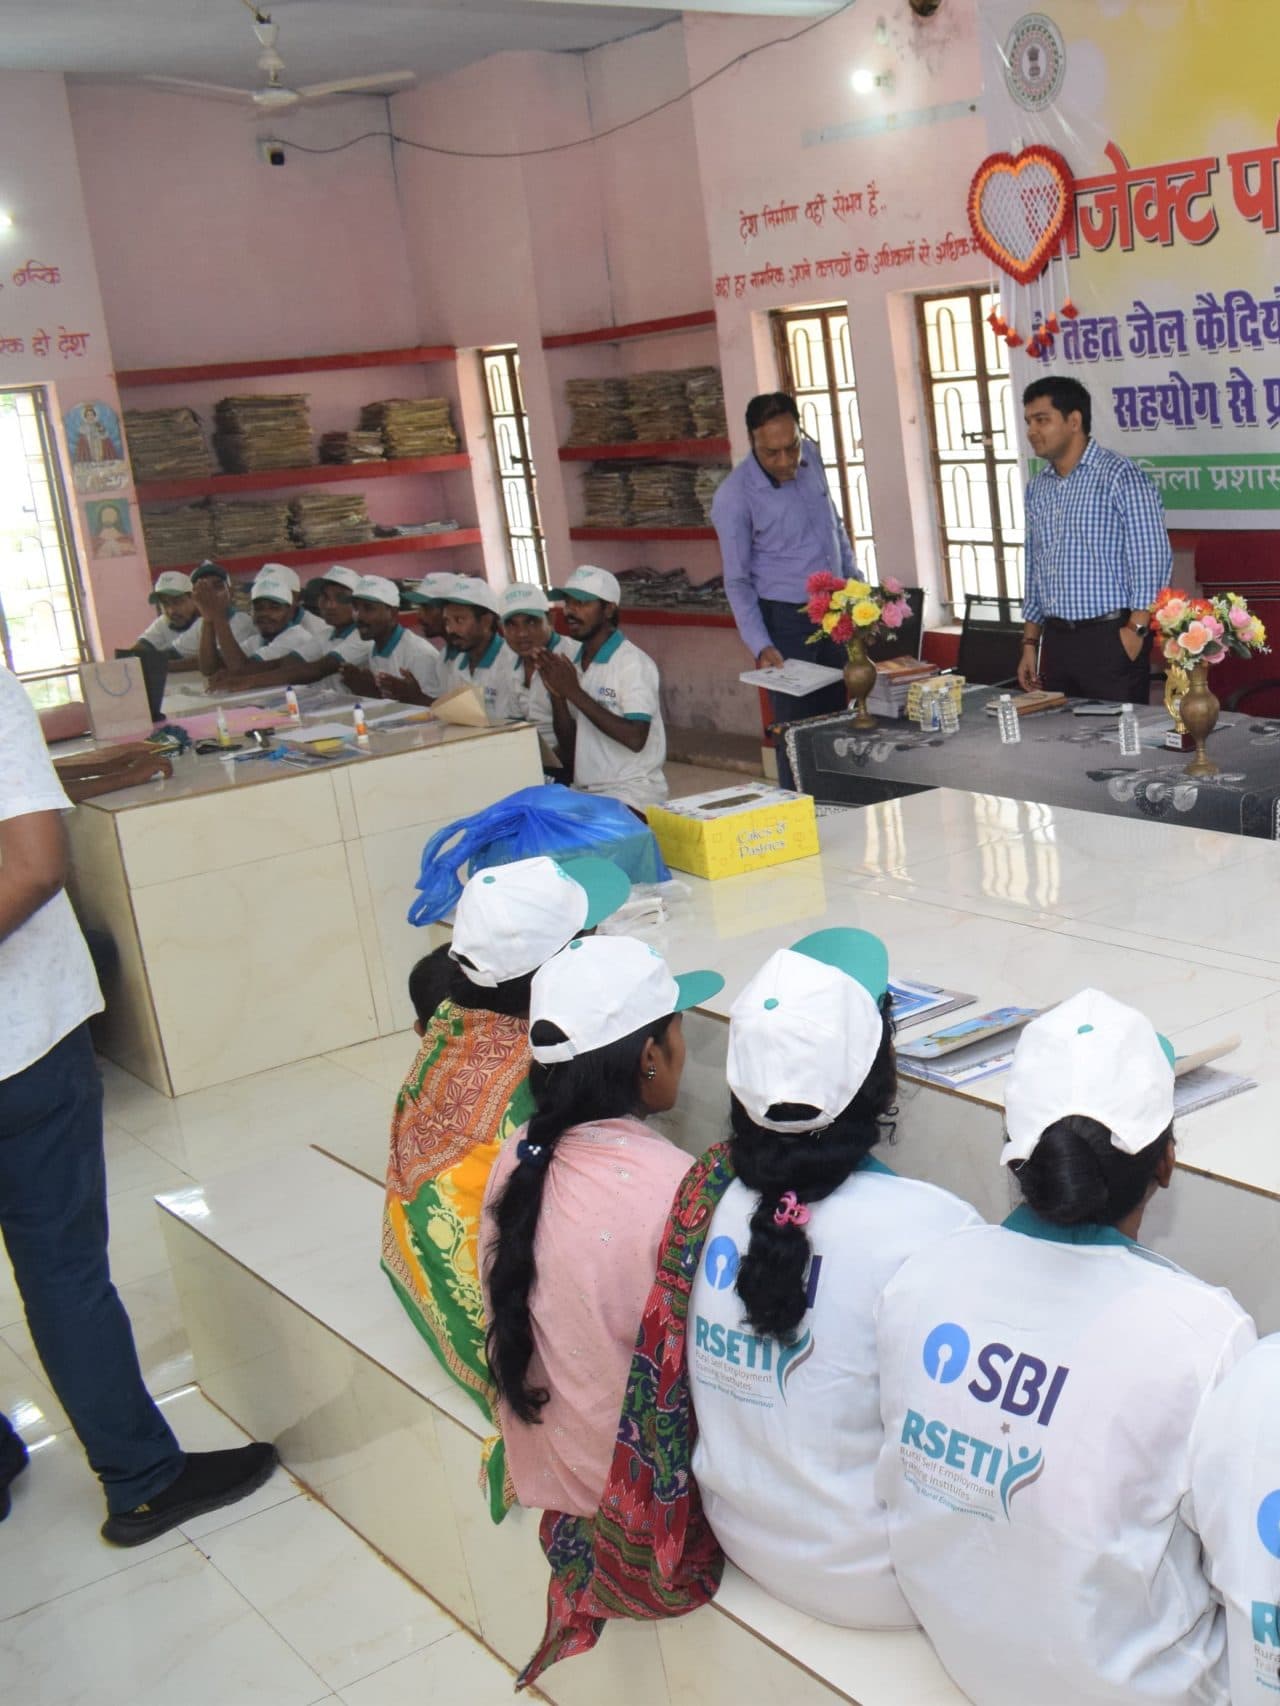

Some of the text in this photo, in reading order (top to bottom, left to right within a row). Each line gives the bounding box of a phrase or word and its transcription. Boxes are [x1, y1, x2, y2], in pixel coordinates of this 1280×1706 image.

[1060, 315, 1124, 364] तहत
[1126, 300, 1190, 357] जेल
[1112, 371, 1222, 432] सहयोग
[1226, 367, 1259, 428] से
[696, 1315, 773, 1371] RSETI
[968, 1342, 1070, 1427] SBI
[901, 1408, 1002, 1485] RSETI
[921, 1457, 937, 1472] Self
[939, 1466, 995, 1498] Employment
